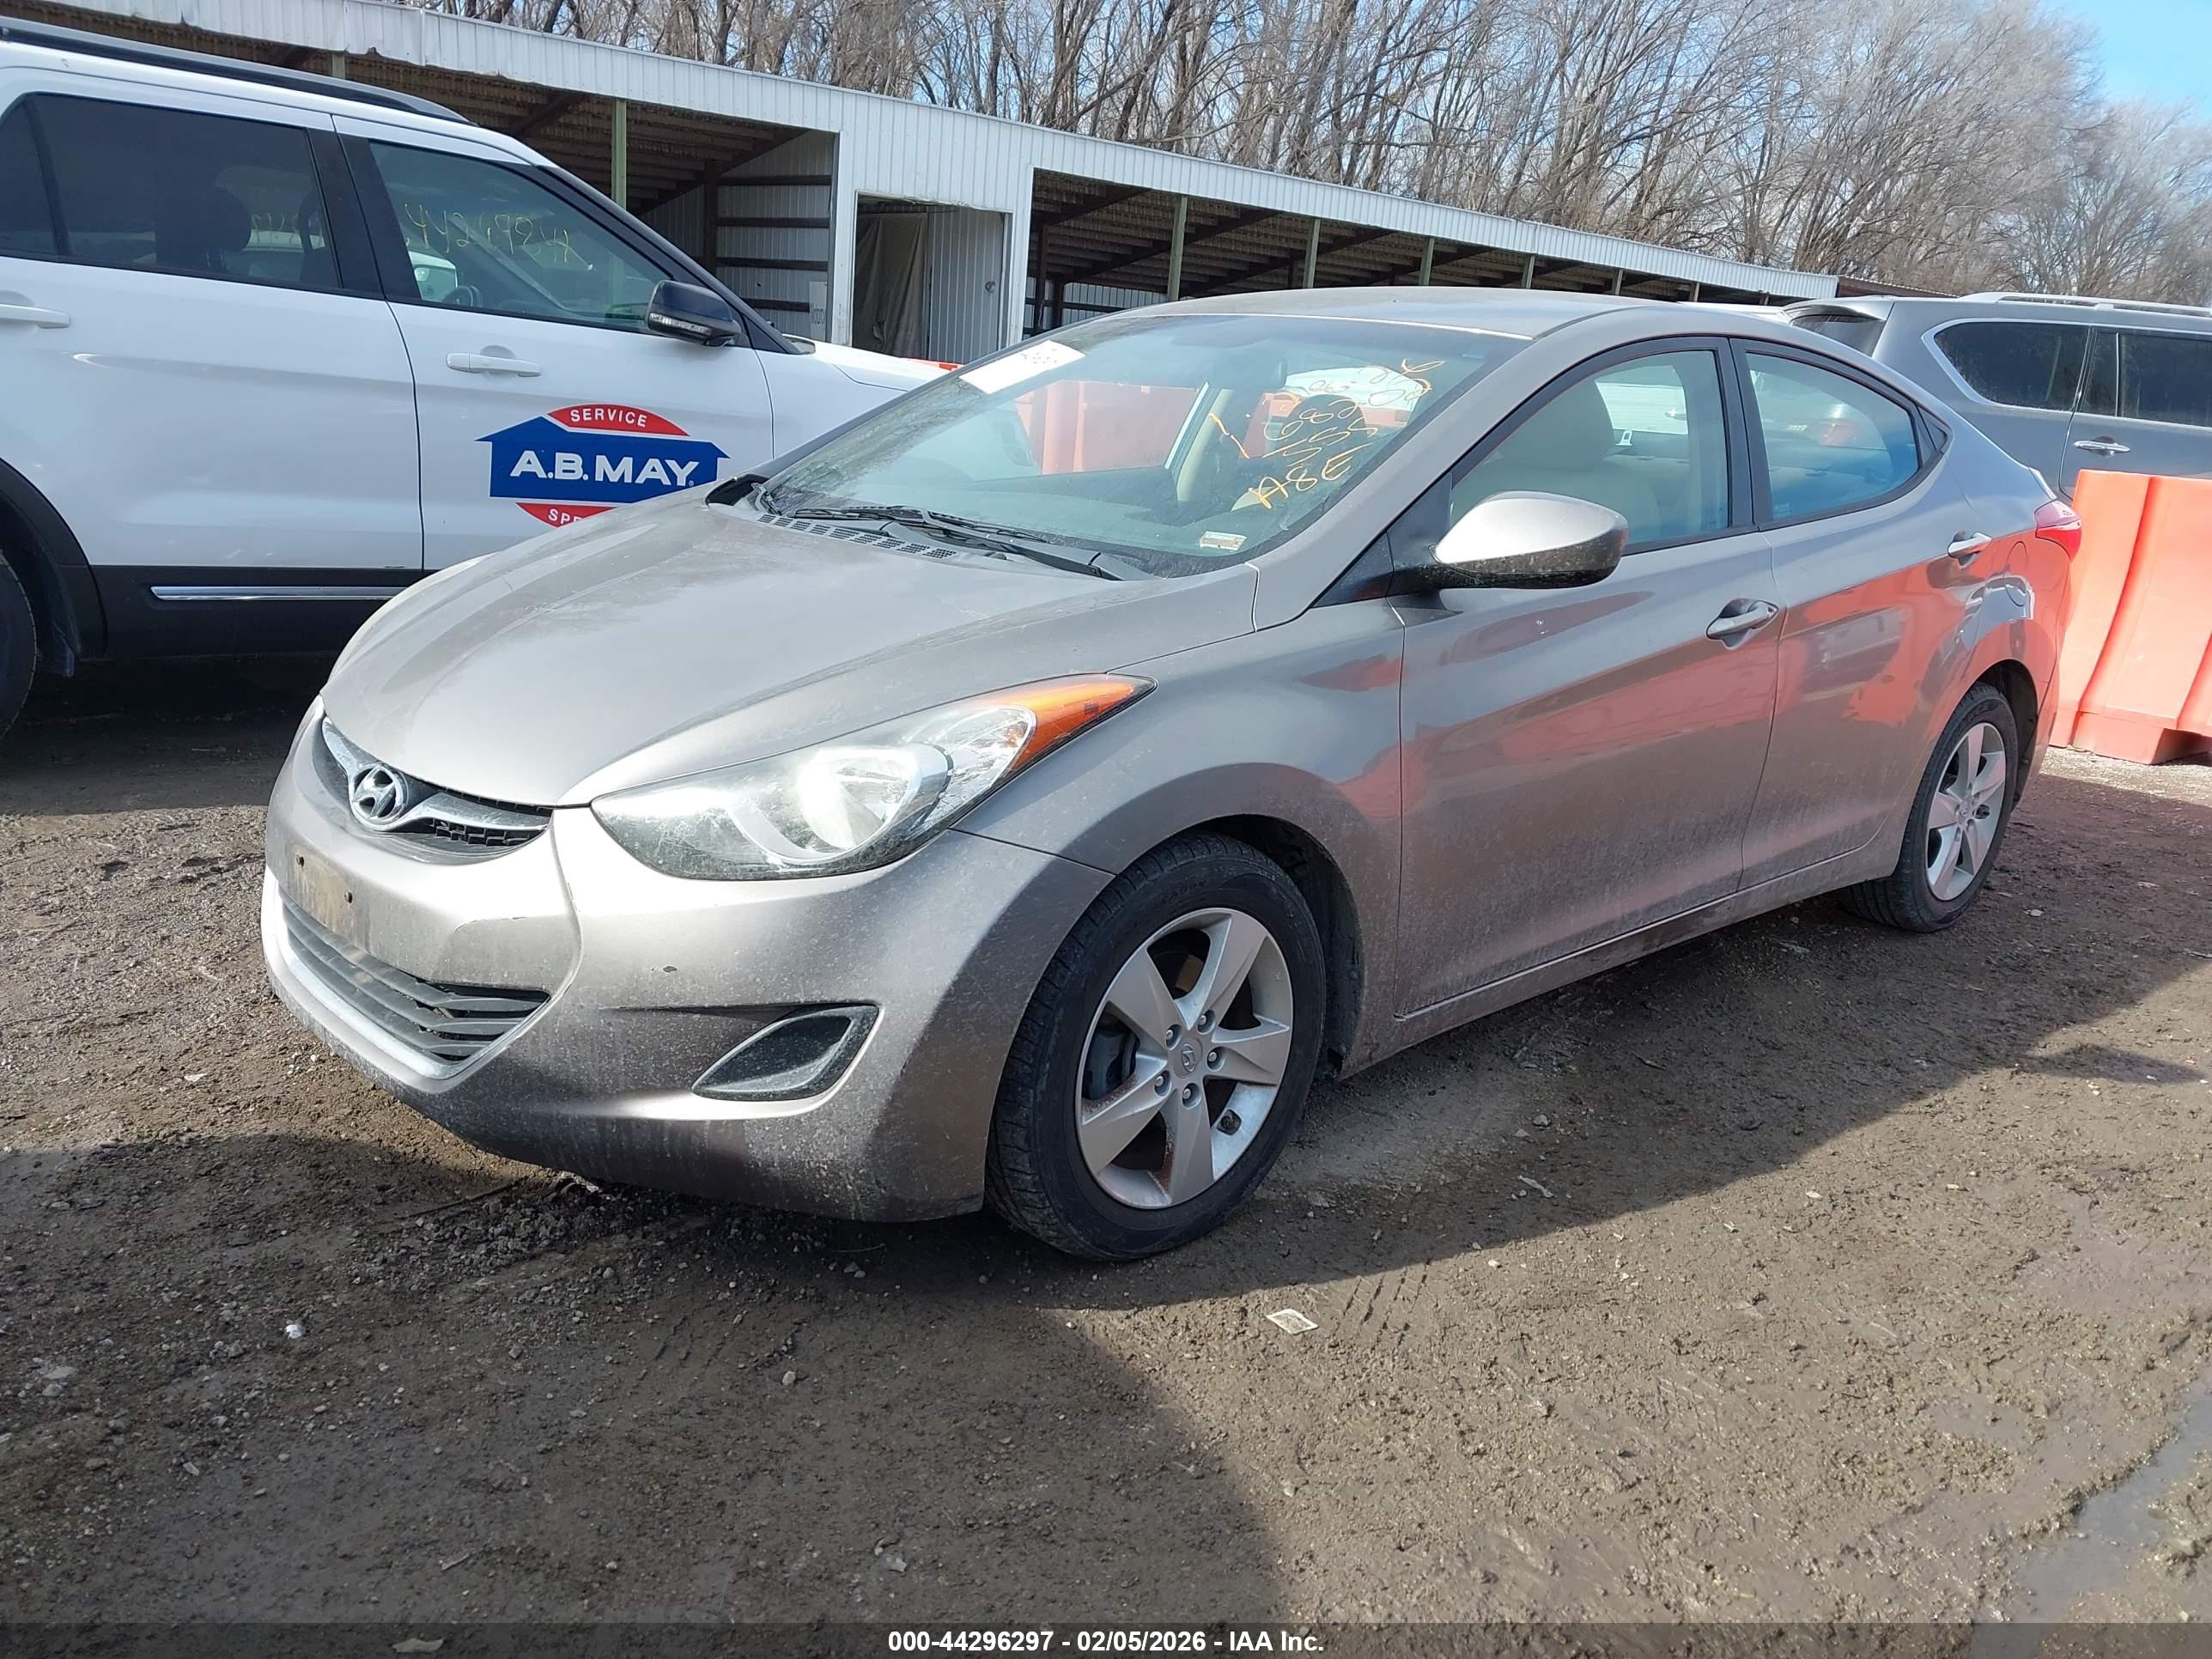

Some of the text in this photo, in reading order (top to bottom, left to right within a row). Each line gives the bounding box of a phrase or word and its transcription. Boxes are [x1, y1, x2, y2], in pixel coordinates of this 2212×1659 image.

[570, 408, 647, 428] SERVICE
[509, 450, 701, 487] A.B. MAY
